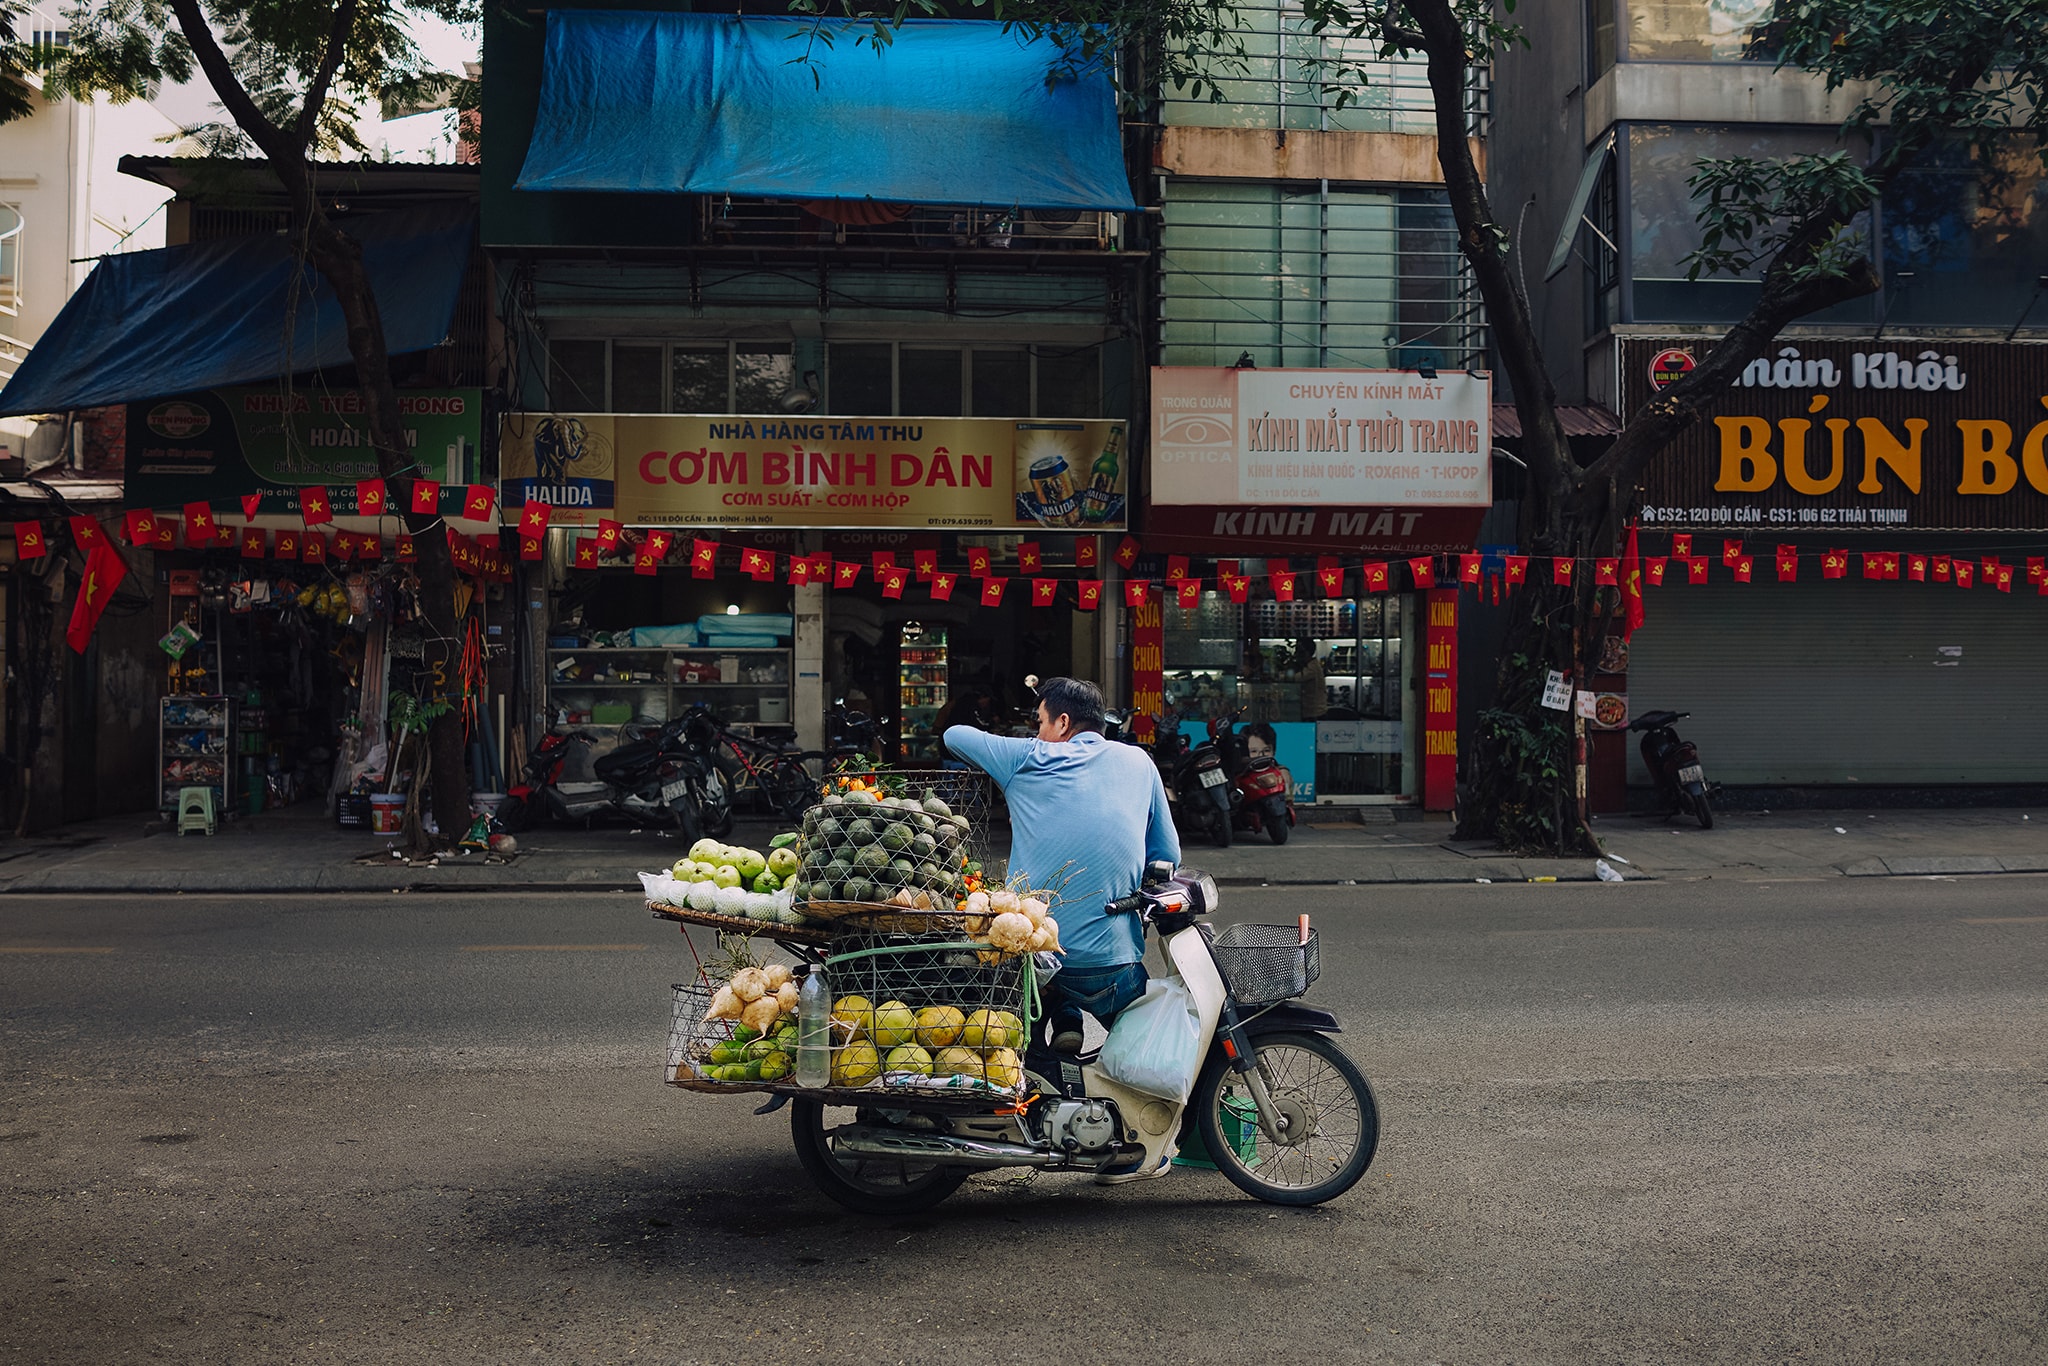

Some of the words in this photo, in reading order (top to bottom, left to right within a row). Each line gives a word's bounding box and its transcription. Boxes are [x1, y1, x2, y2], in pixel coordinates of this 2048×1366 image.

[1852, 350, 1966, 392] Khôi
[1289, 382, 1358, 400] CHUYÊN
[1364, 382, 1402, 400] KÍNH
[1408, 379, 1444, 400] MẮT
[397, 396, 465, 415] HONG
[1160, 397, 1197, 412] TRỌNG
[709, 421, 756, 440] NHÀ
[761, 421, 825, 440] HÀNG
[829, 423, 874, 441] TÂM
[879, 426, 922, 442] THU
[1247, 410, 1299, 453] KÍNH
[1305, 407, 1351, 453] MẮT
[1356, 410, 1403, 454] THỜI
[1410, 419, 1479, 454] TRANG
[1713, 394, 1929, 496] BÚN
[638, 448, 748, 485] CƠM
[763, 445, 876, 487] BÌNH
[890, 446, 993, 488] DÂN
[1161, 450, 1233, 464] OPTICA
[1247, 462, 1273, 478] KÍNH
[1276, 462, 1300, 481] HIỆU
[1303, 462, 1324, 478] HÀN
[1328, 460, 1356, 479] QUỐC
[1365, 465, 1420, 480] ROXANA
[1431, 466, 1479, 480] T-KPOP
[525, 485, 593, 505] HALIDA
[722, 492, 763, 506] CƠM
[768, 490, 813, 507] SUẤT
[826, 492, 867, 507] CƠM
[872, 492, 910, 511] HỘP
[1041, 498, 1076, 517] HALIDA
[1658, 506, 1687, 522] CS2:
[1688, 506, 1710, 522] 120
[1711, 505, 1732, 524] ĐỘI
[1735, 504, 1762, 522] CẤN
[1769, 507, 1796, 523] CS1:
[1797, 507, 1818, 523] 106
[1820, 507, 1837, 523] G2
[1839, 505, 1867, 523] THÁI
[1870, 508, 1908, 525] THỊNH
[668, 515, 683, 523] ĐỘI
[684, 514, 702, 522] CẤN
[720, 515, 740, 523] ĐÌNH
[745, 515, 757, 523] HÀ
[758, 516, 773, 524] NỘI
[1212, 508, 1316, 536] KÍNH
[1431, 597, 1455, 627] KÍNH
[1133, 642, 1162, 671] CHỮA
[1429, 635, 1452, 669] MẮT
[1429, 682, 1452, 713] THỜI
[1425, 730, 1457, 756] TRANG
